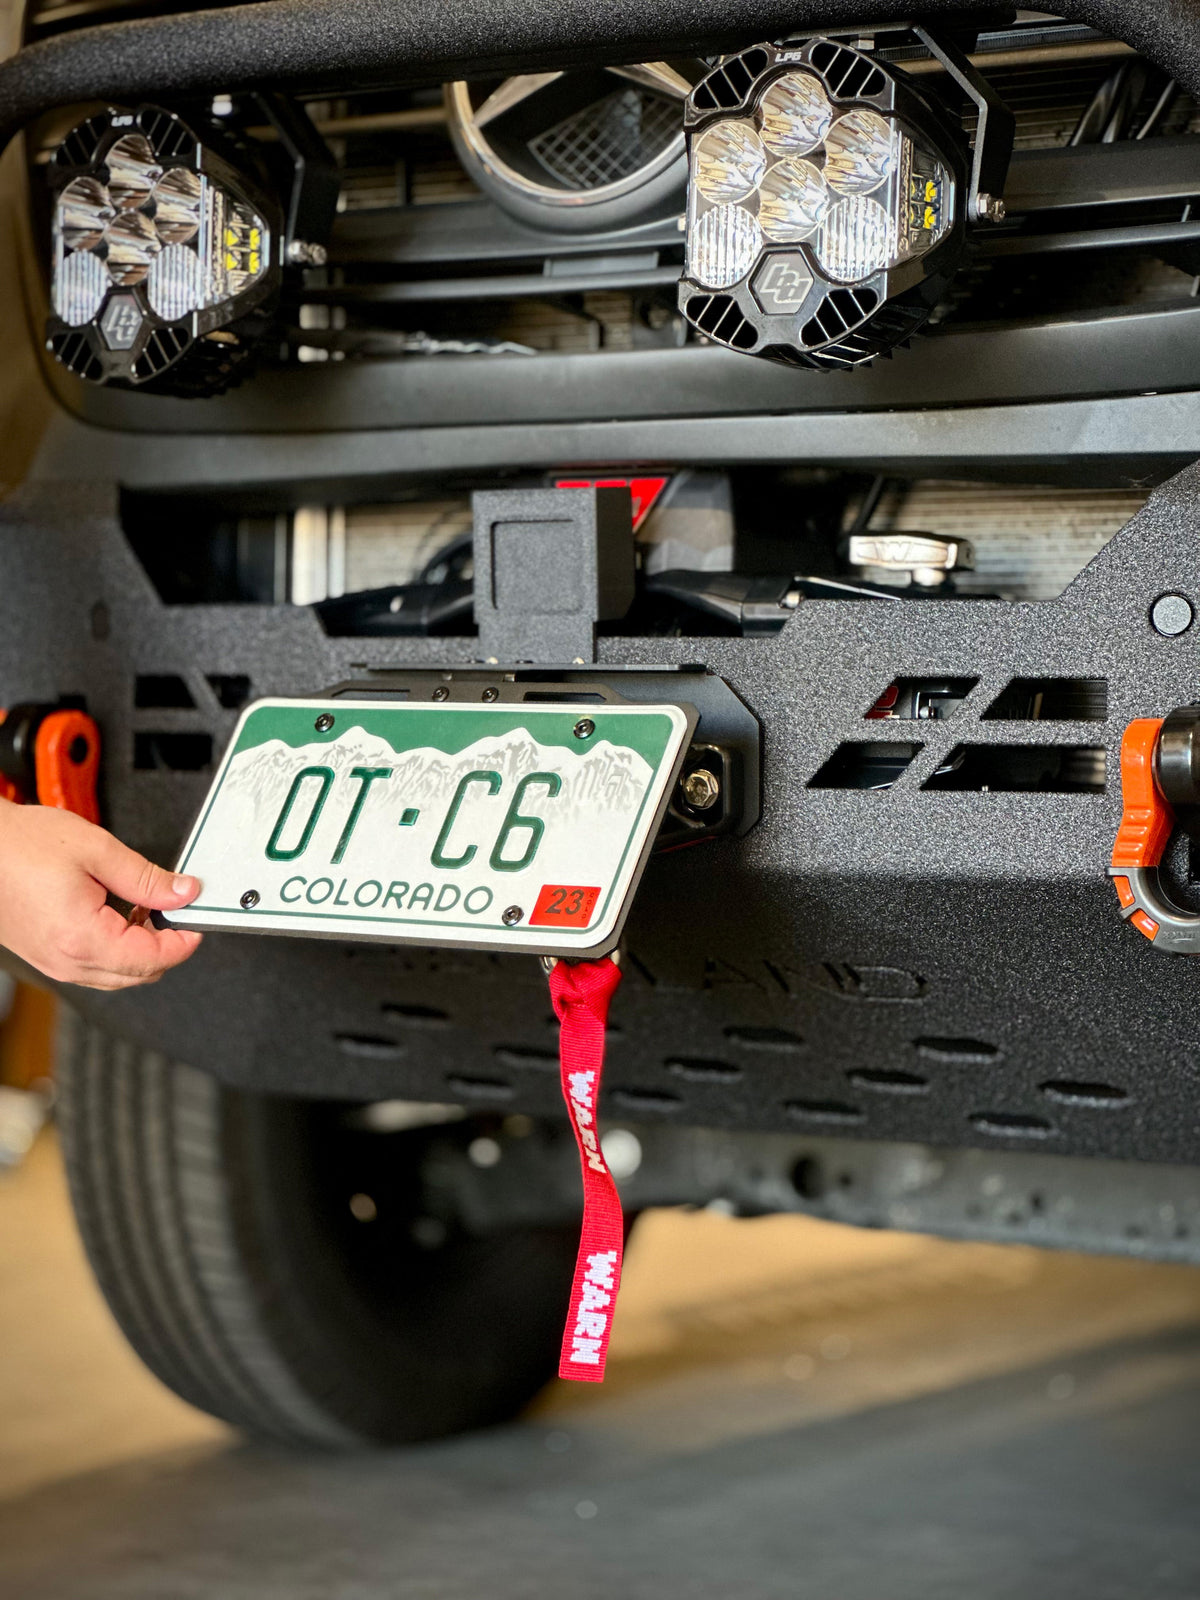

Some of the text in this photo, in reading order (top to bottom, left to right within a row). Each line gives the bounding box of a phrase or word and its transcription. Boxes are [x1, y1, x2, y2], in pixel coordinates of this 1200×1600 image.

[279, 875, 494, 915] COLORADO
[545, 888, 585, 915] 23
[568, 1070, 607, 1174] WARN
[569, 1251, 617, 1365] WARN
